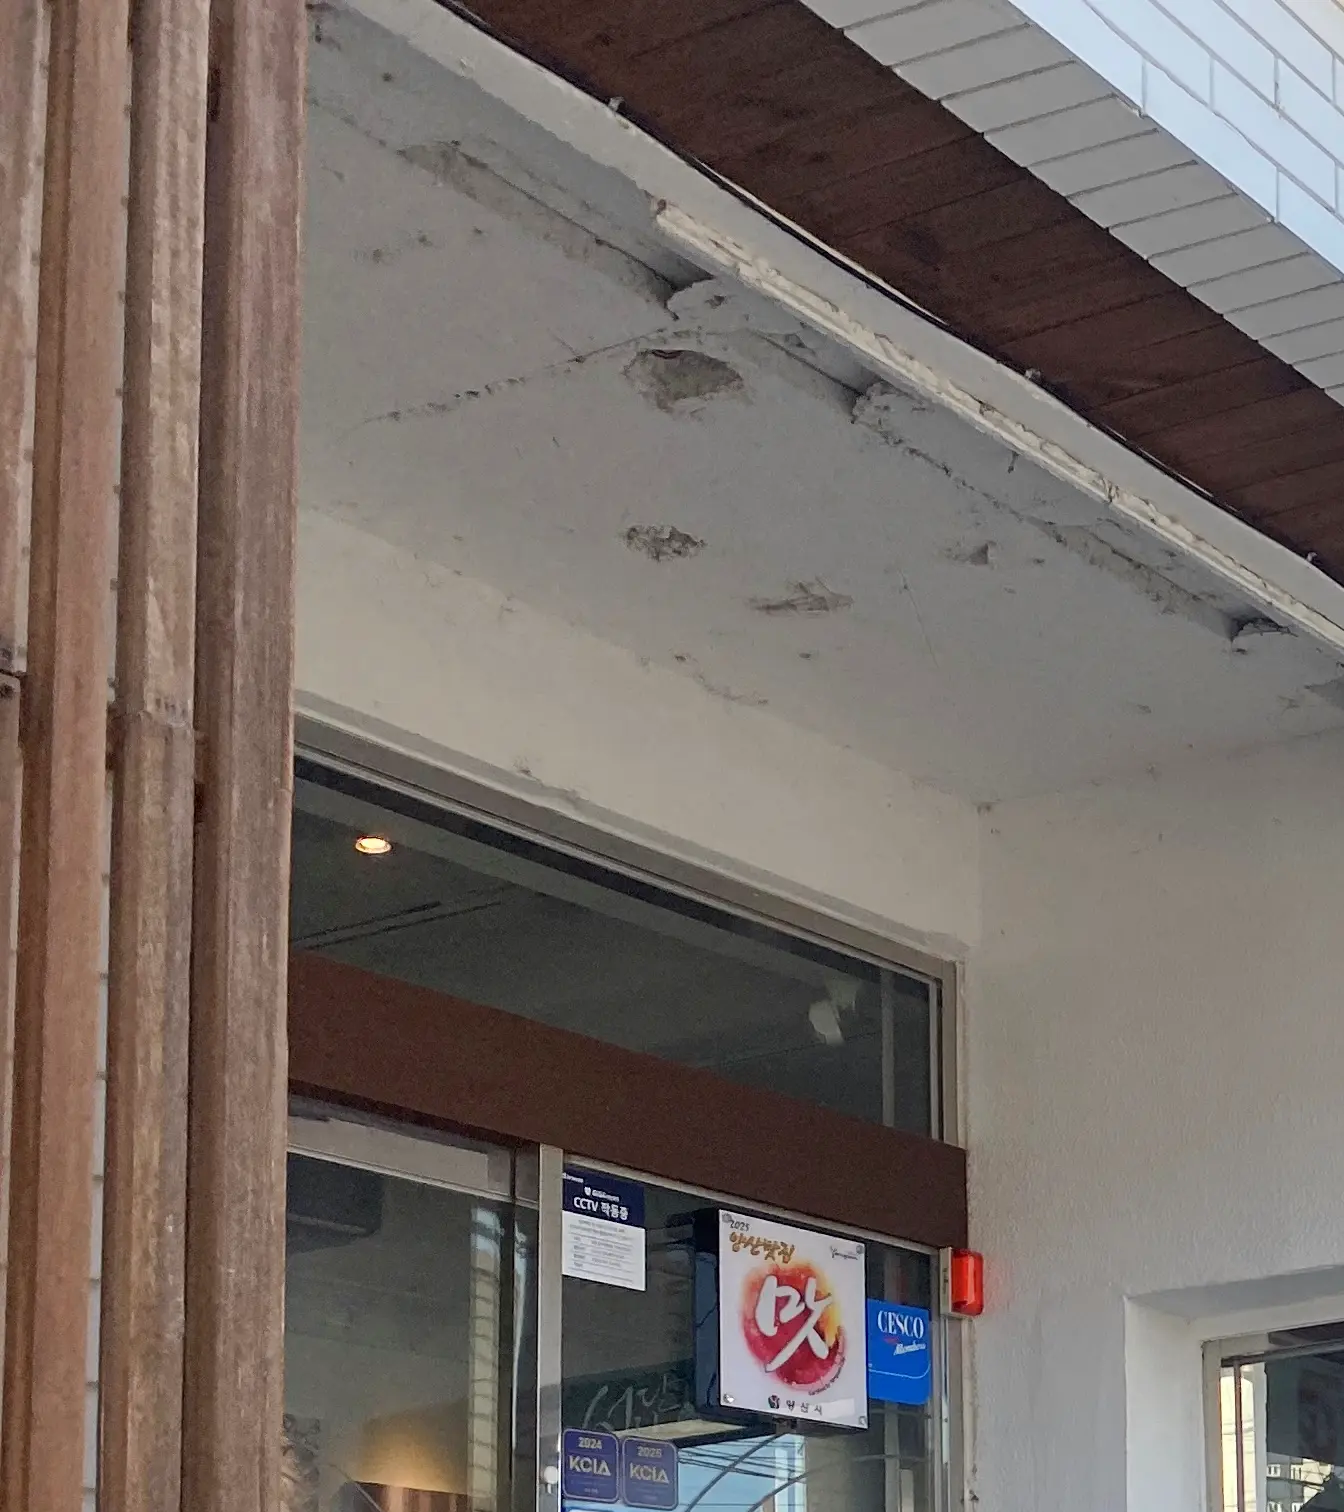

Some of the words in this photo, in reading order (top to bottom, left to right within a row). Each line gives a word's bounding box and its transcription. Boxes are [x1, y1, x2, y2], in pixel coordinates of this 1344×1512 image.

[573, 1196, 598, 1212] CCTV
[600, 1201, 629, 1220] 작동중
[757, 1273, 833, 1373] 맛
[877, 1310, 924, 1339] CESCO
[578, 1437, 602, 1449] 2024
[569, 1455, 611, 1476] KCIA
[629, 1462, 670, 1484] KCIA
